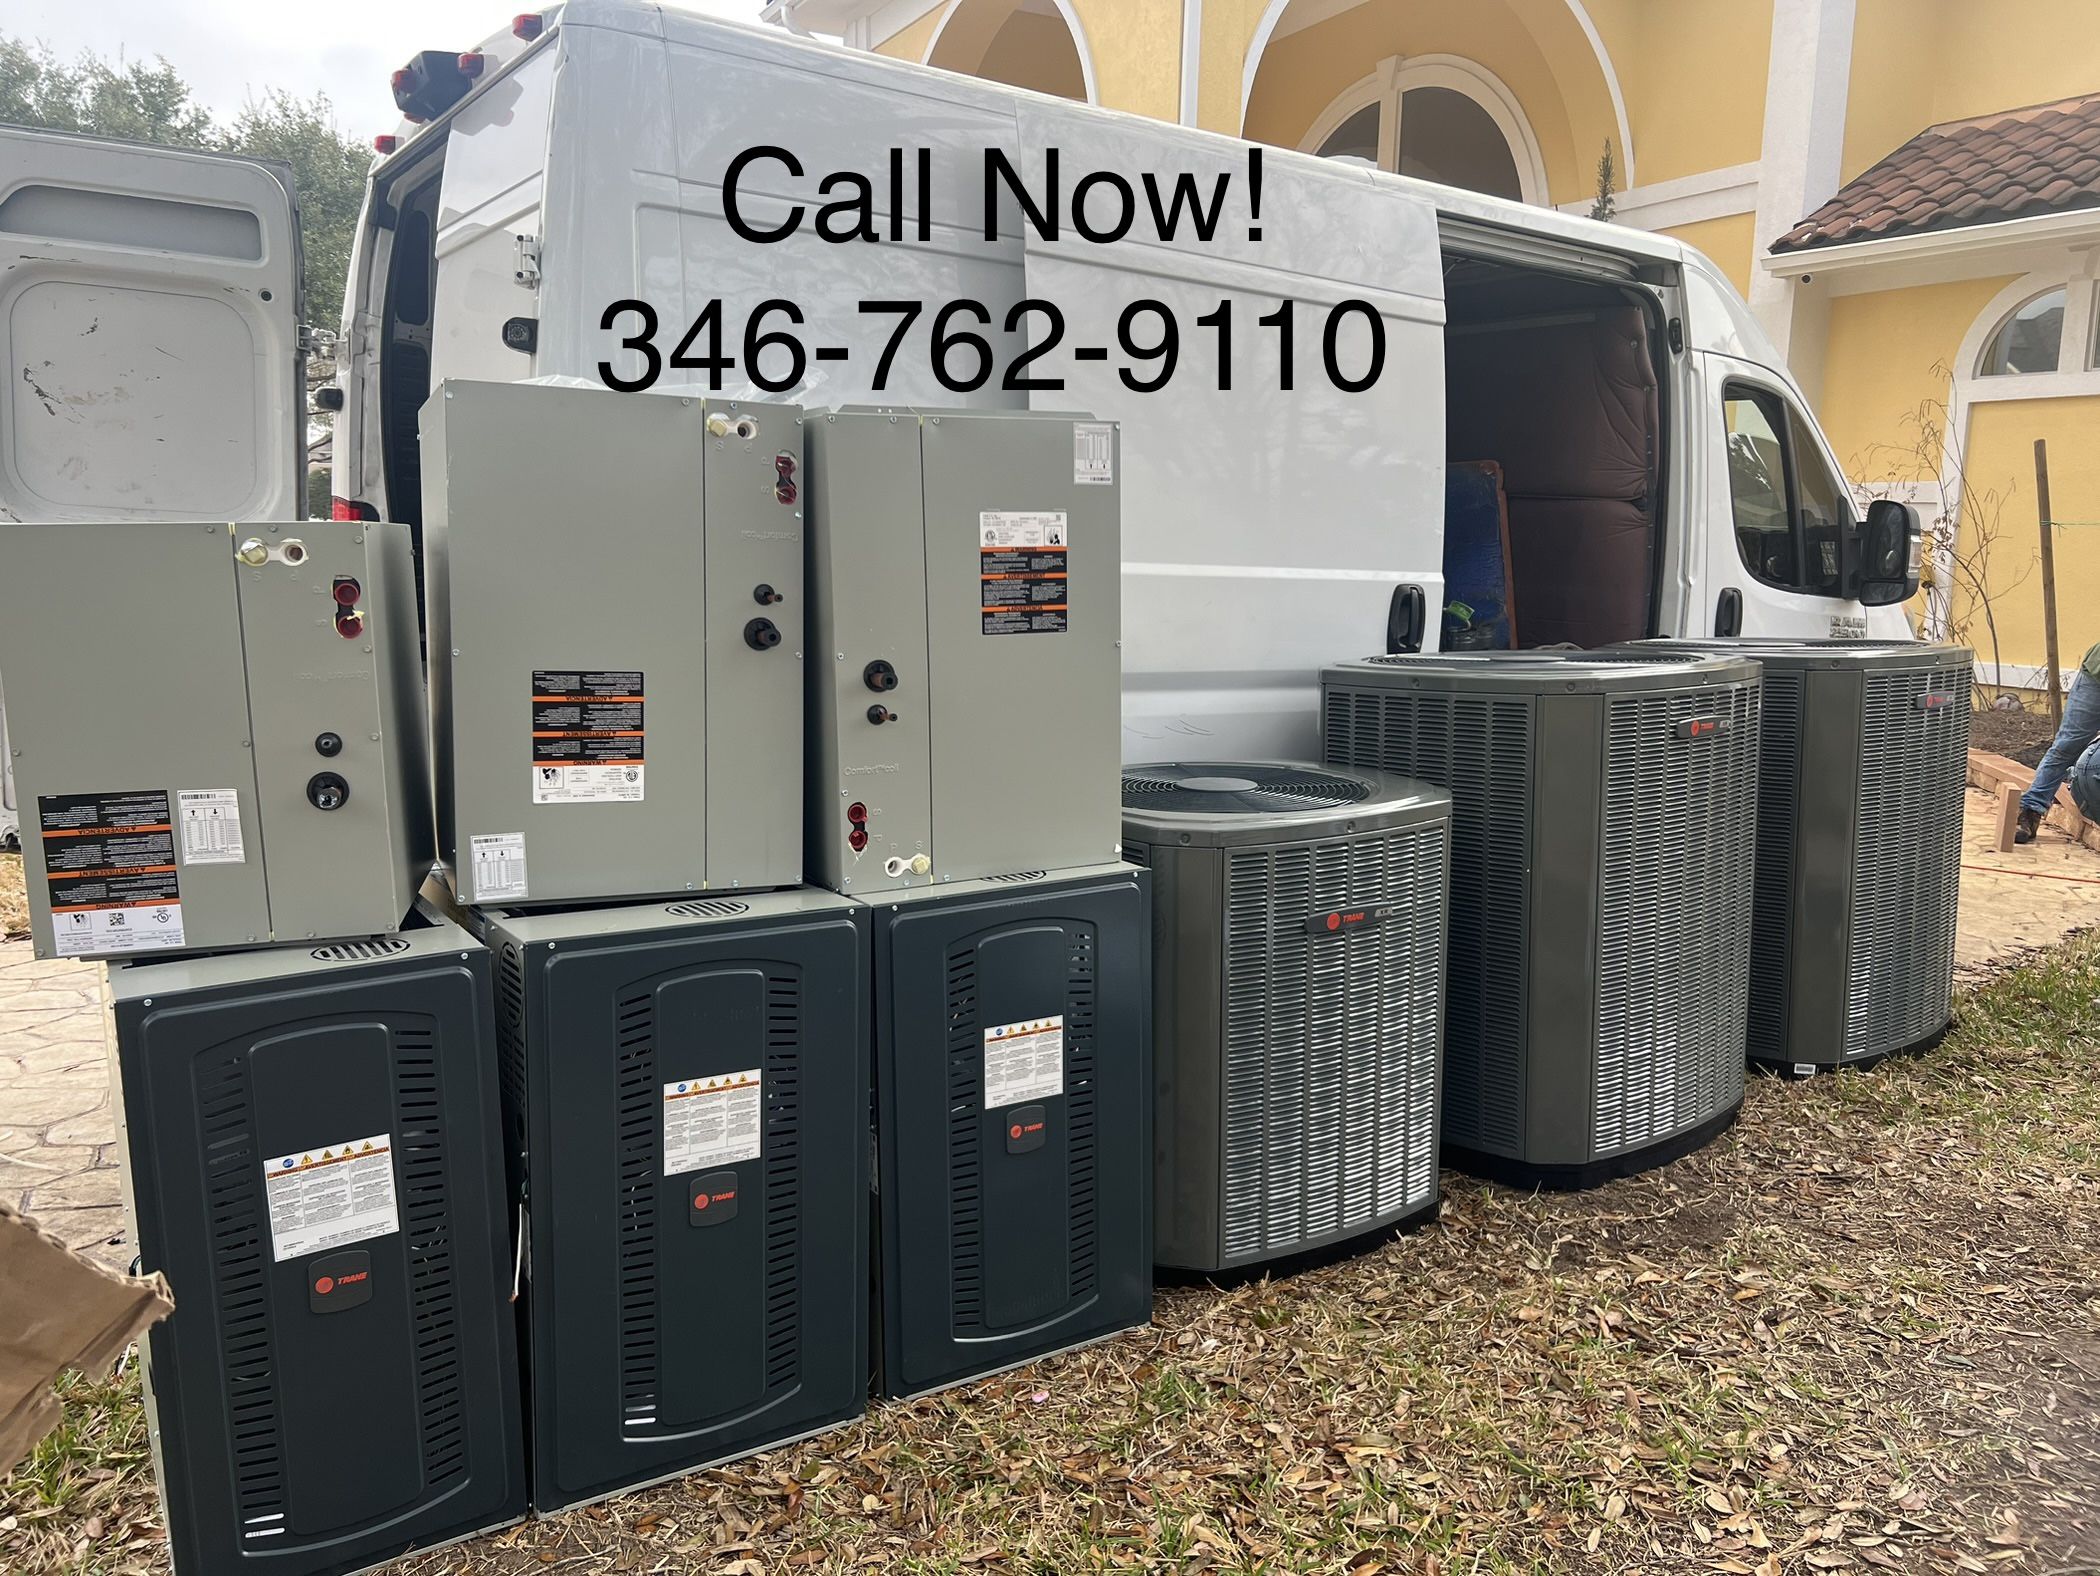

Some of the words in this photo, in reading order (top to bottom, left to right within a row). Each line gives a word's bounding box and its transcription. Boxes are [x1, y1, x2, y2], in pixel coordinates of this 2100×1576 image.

[78, 826, 131, 835] ADVERTENCIA
[80, 867, 139, 877] AVERTISSEMENT
[95, 902, 132, 910] WARNING
[1343, 912, 1365, 923] TRANE
[712, 1191, 735, 1202] TRANE
[337, 1271, 368, 1285] TRANE
